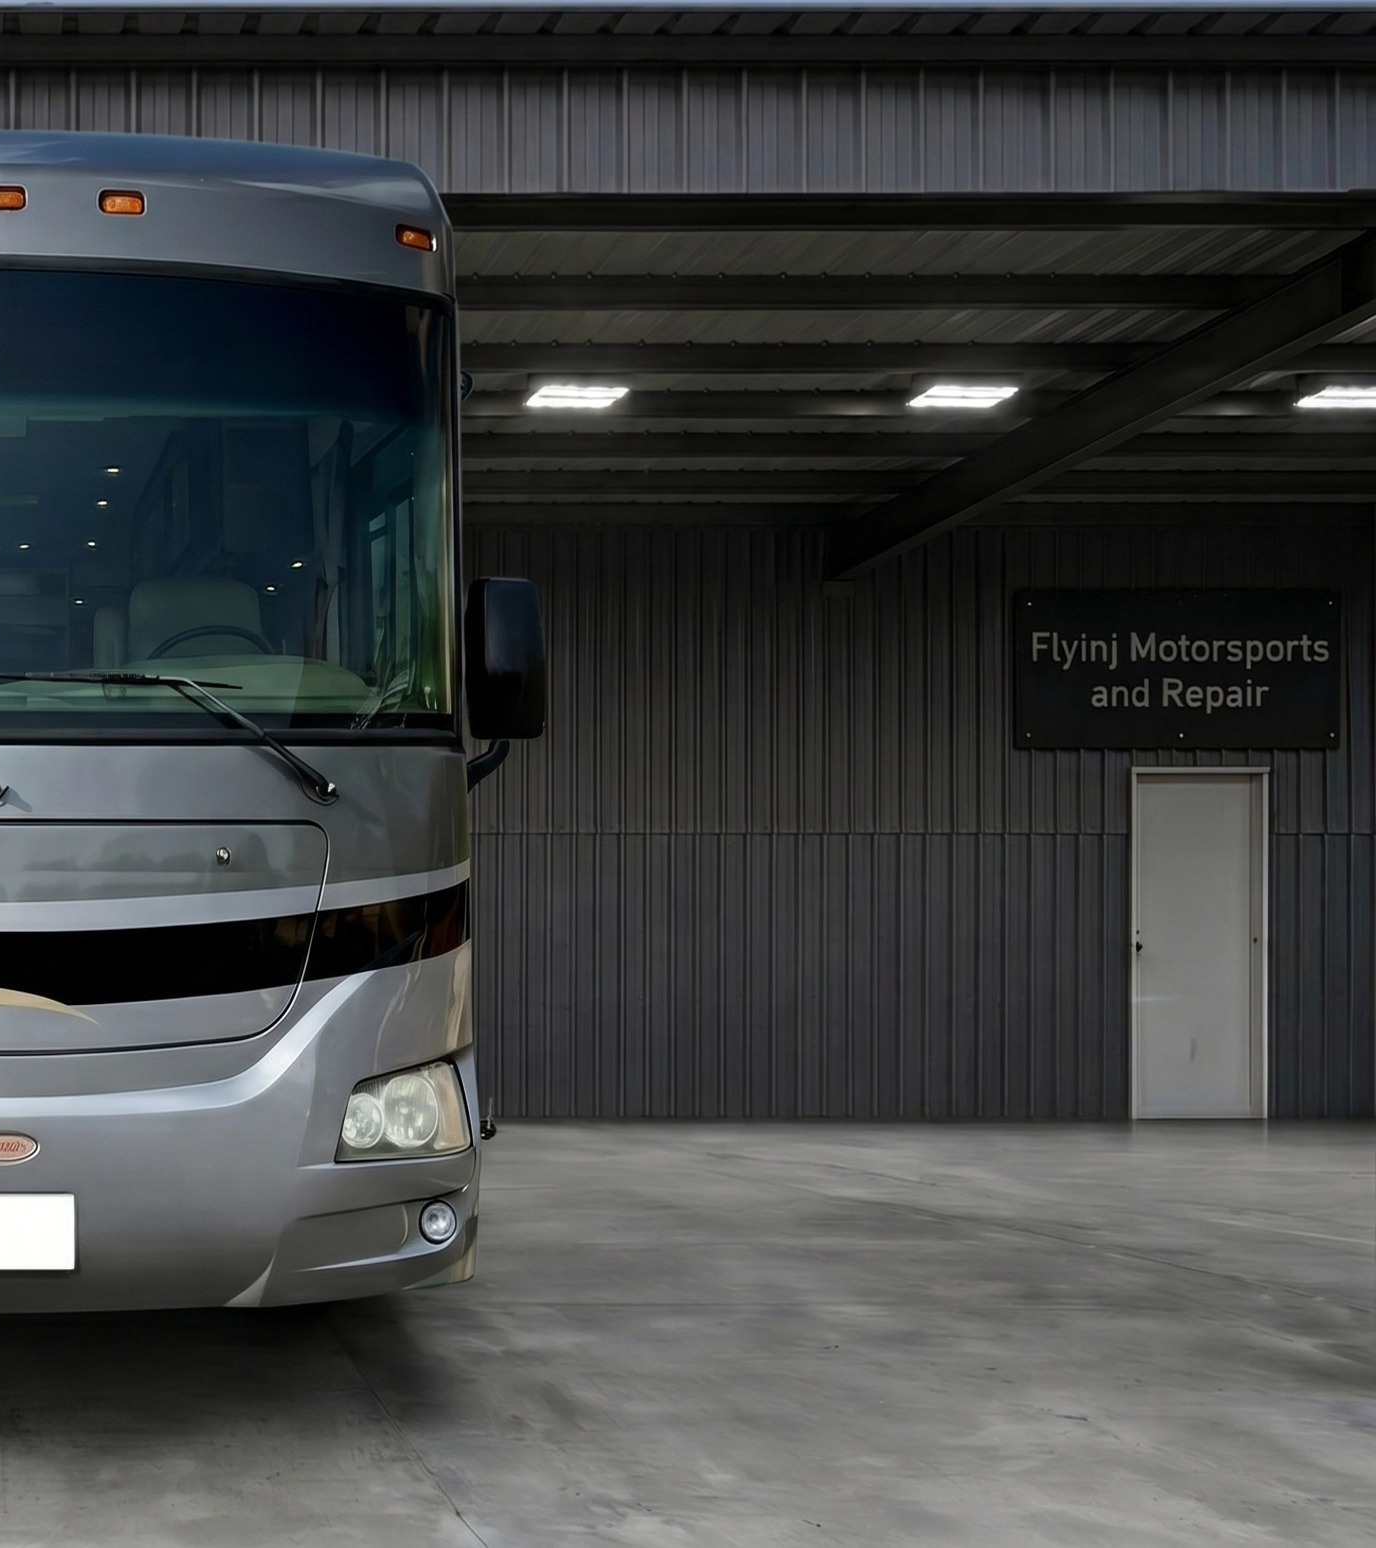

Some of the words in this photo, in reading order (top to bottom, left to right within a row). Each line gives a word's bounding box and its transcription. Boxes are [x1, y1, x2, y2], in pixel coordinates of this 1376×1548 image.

[1032, 632, 1118, 670] Flyinj
[1130, 632, 1330, 670] Motorsports
[1091, 678, 1150, 708] and
[1162, 677, 1270, 714] Repair
